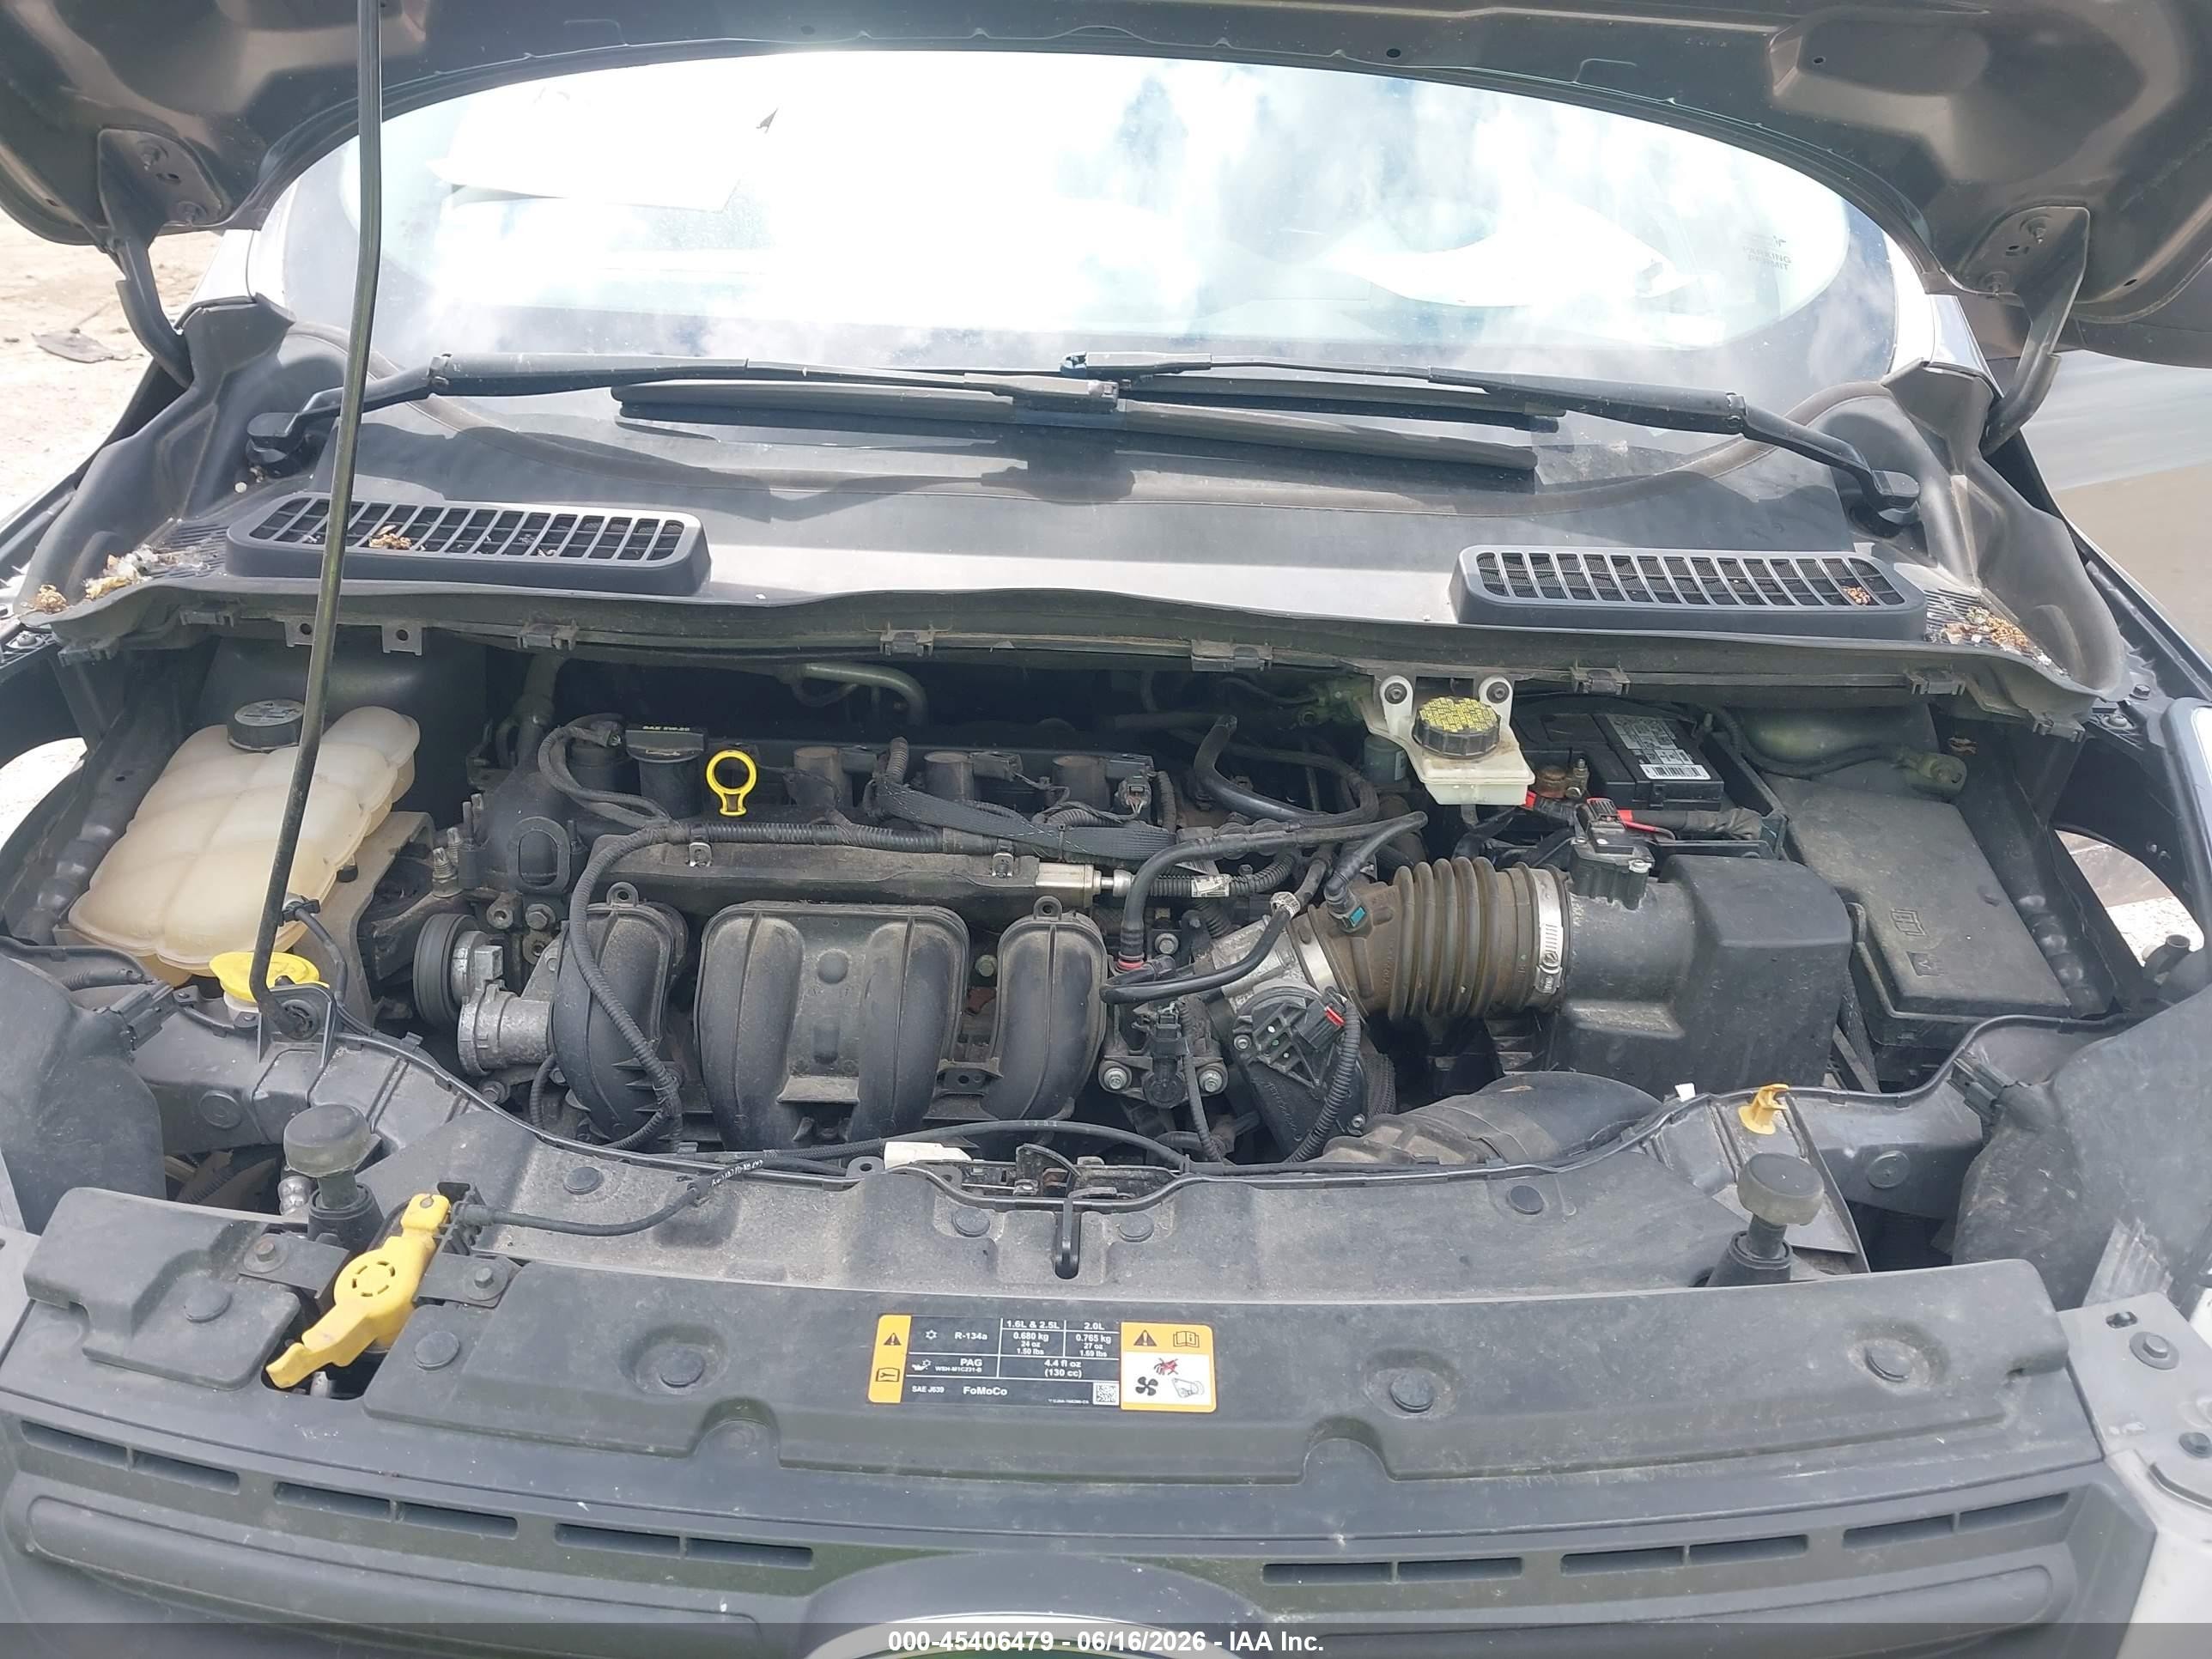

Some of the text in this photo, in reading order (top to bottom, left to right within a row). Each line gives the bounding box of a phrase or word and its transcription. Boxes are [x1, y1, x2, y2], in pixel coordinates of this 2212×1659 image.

[1006, 1320, 1027, 1328] 1.6L
[1039, 1321, 1060, 1329] 2.5L
[1084, 1322, 1105, 1331] 2.0L
[954, 1331, 988, 1340] R-134a
[1013, 1331, 1049, 1342] 0.680 kg
[1075, 1334, 1112, 1344] 0.765 kg
[960, 1358, 983, 1367] PAG
[1044, 1368, 1082, 1378] (130 cc)
[963, 1386, 1008, 1395] FoMoCo
